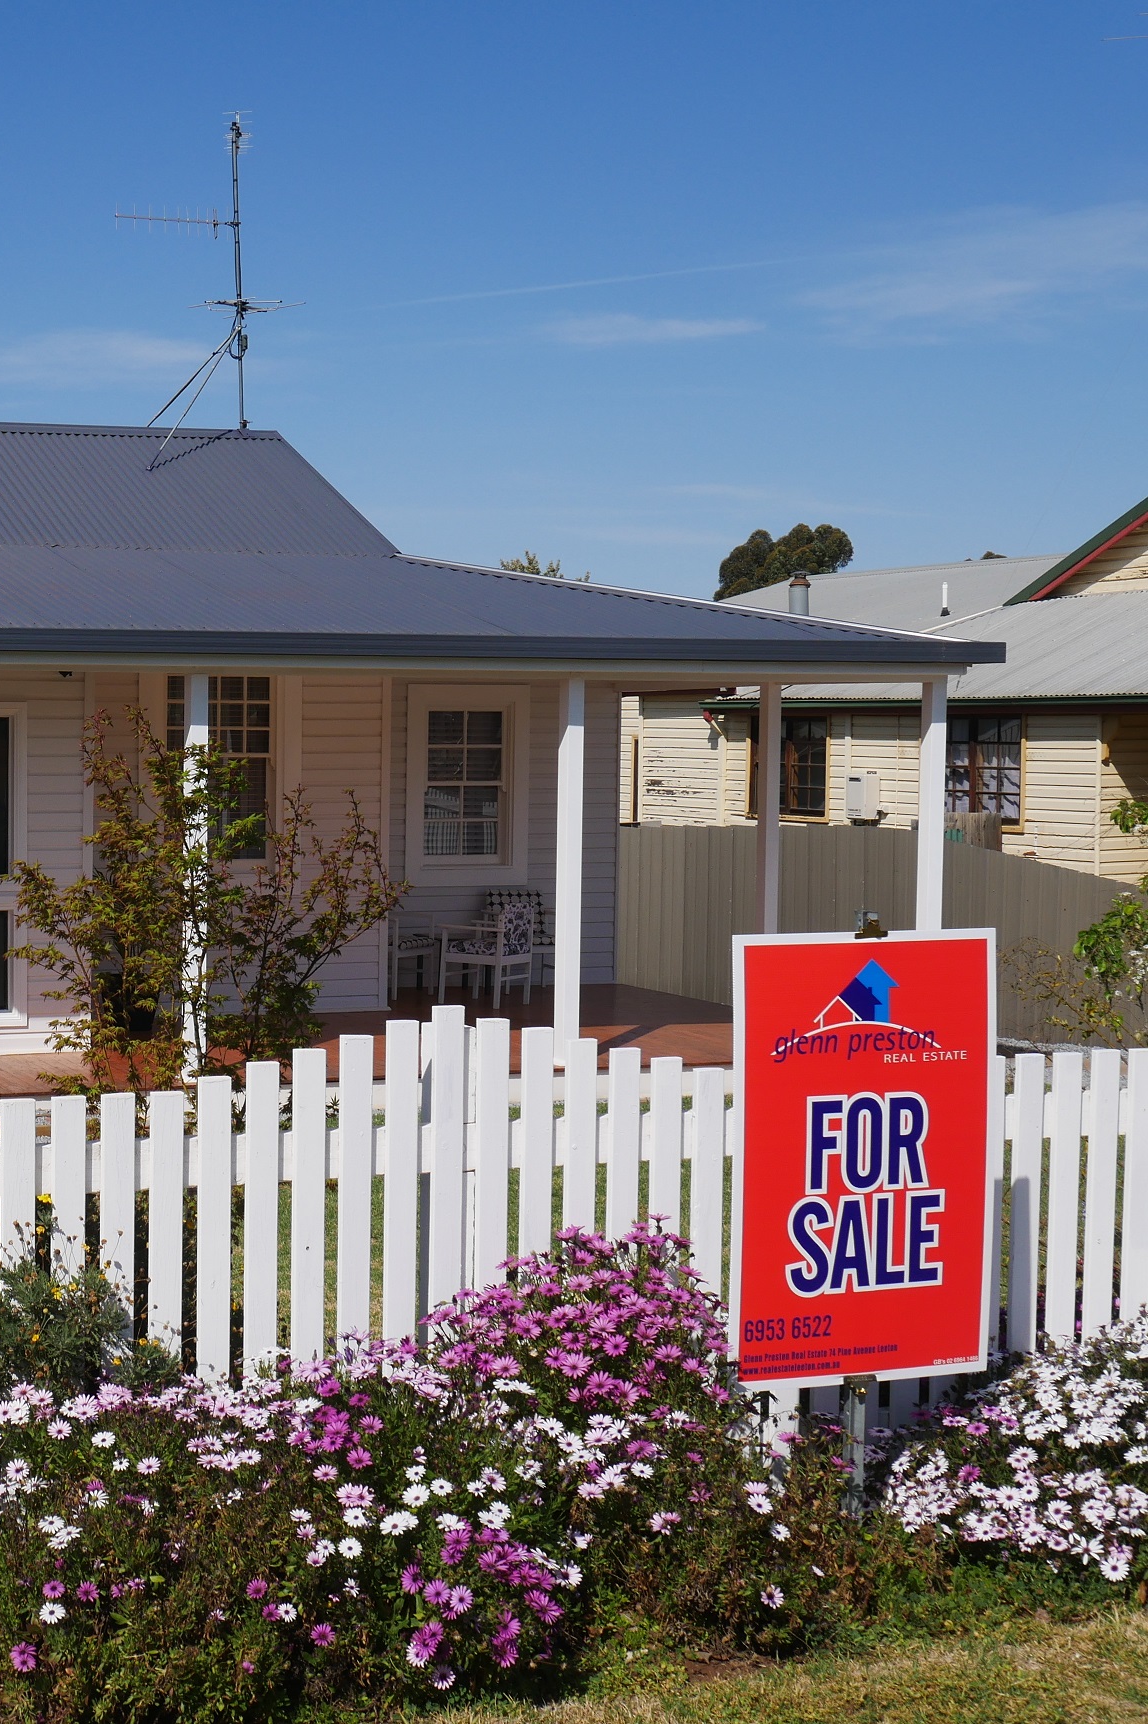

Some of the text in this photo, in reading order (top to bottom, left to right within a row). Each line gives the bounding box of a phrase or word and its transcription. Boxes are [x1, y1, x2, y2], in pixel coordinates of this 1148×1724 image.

[774, 1026, 935, 1063] glenn preston
[884, 1050, 968, 1064] REAL ESTATE
[805, 1091, 929, 1195] FOR
[785, 1188, 945, 1298] SALE
[744, 1315, 832, 1343] 6953 6522
[743, 1355, 763, 1363] Glenn
[764, 1353, 790, 1361] Preston
[791, 1350, 806, 1360] Real
[807, 1349, 828, 1359] Estate
[837, 1347, 852, 1357] Pine
[743, 1361, 840, 1375] www.realestateleeton.com.au
